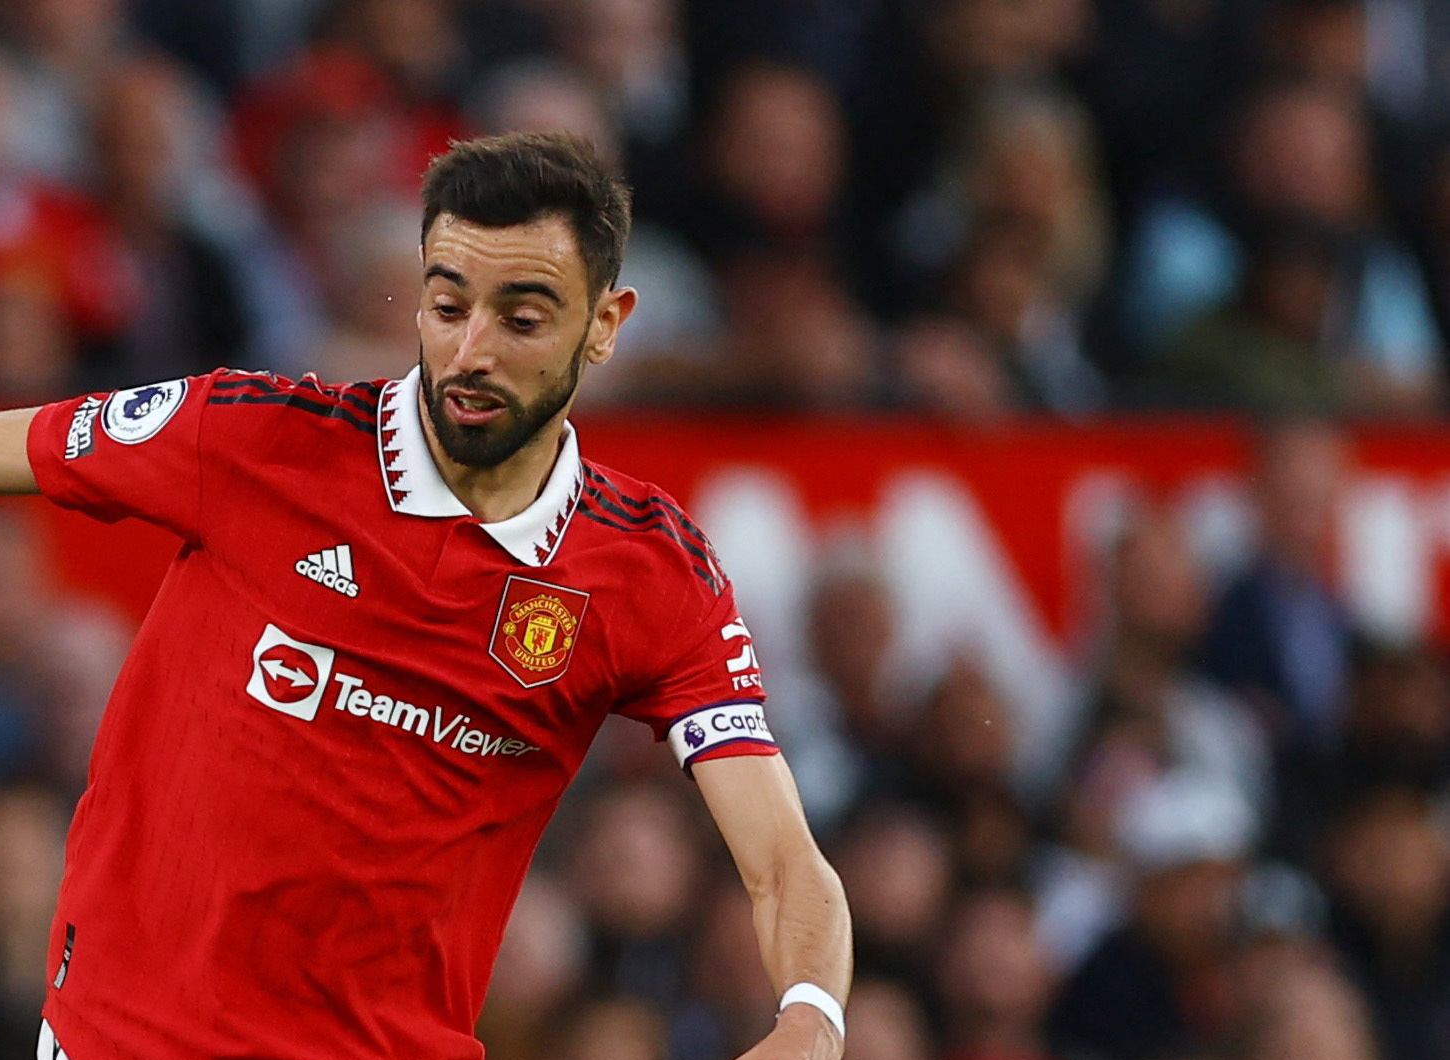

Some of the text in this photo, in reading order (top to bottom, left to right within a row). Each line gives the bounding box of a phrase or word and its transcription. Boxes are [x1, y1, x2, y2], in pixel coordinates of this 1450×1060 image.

[295, 559, 359, 598] adidas
[514, 599, 573, 632] MANCHESTER
[513, 647, 557, 667] UNITED
[333, 672, 541, 758] TeamViewer
